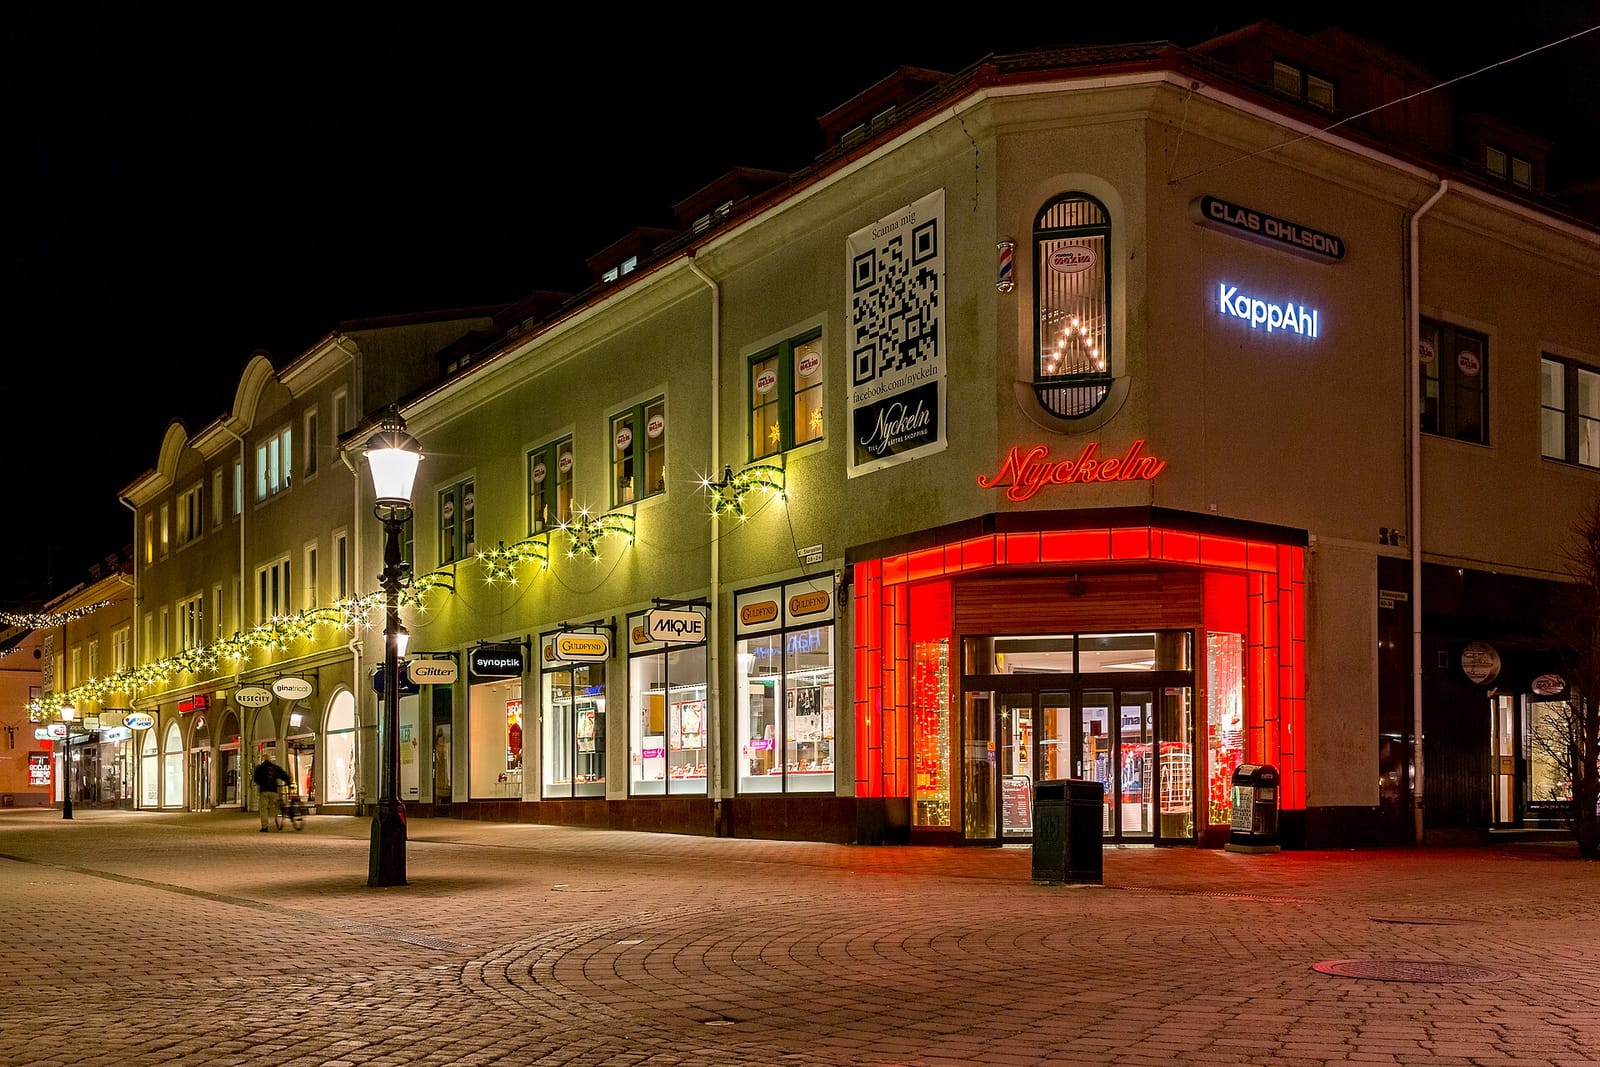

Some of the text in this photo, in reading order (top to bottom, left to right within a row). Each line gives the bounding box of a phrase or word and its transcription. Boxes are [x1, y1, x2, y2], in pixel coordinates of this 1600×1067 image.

[872, 211, 916, 240] Scanna mig
[1210, 202, 1339, 256] CLAS OHLSON
[1054, 253, 1091, 265] maxim
[1220, 283, 1318, 338] KappAhl
[853, 364, 938, 403] facebook.com/nyckeln
[860, 400, 931, 454] Nyckeln
[904, 428, 928, 441] SHOPPING
[977, 439, 1167, 502] Nyckeln
[791, 597, 826, 612] GULDFYND
[742, 606, 775, 621] GULDFYND
[654, 619, 702, 636] MIQUE
[562, 641, 602, 651] GULDFYND
[477, 658, 520, 668] synoptik
[415, 667, 454, 676] Glitter
